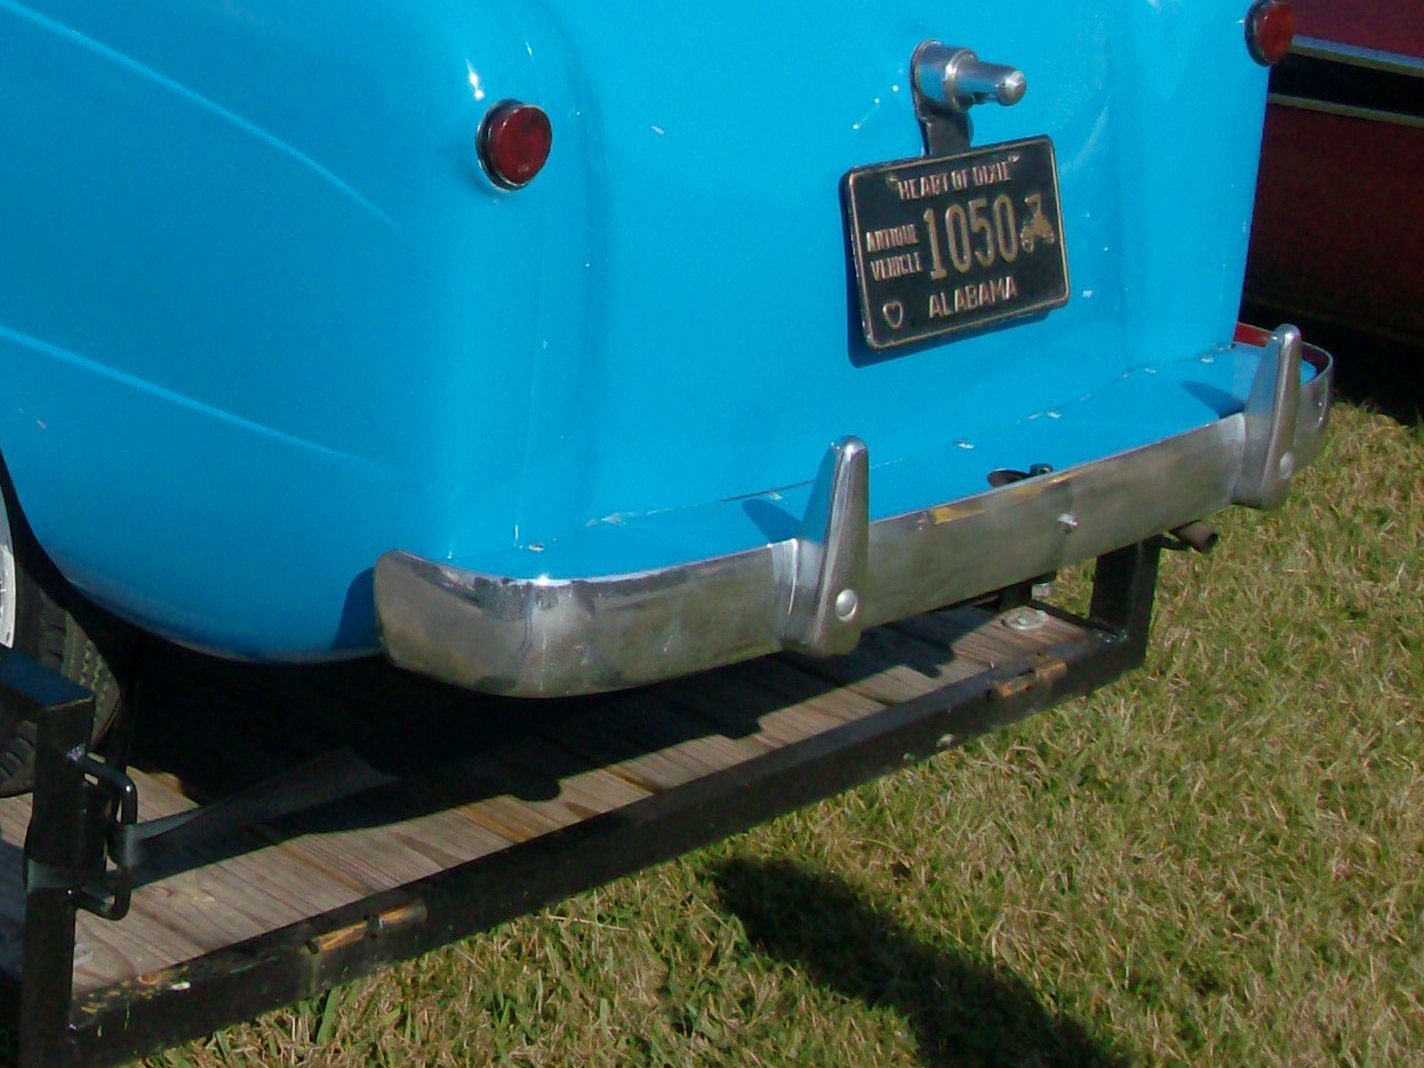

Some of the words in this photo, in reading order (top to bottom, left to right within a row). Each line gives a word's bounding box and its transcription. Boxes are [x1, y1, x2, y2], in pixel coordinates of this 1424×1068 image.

[950, 168, 968, 190] OF
[865, 223, 920, 253] ANTIQUE
[923, 194, 1019, 280] 1050
[870, 251, 924, 281] VEHICLE
[928, 275, 1019, 319] ALABAMA
